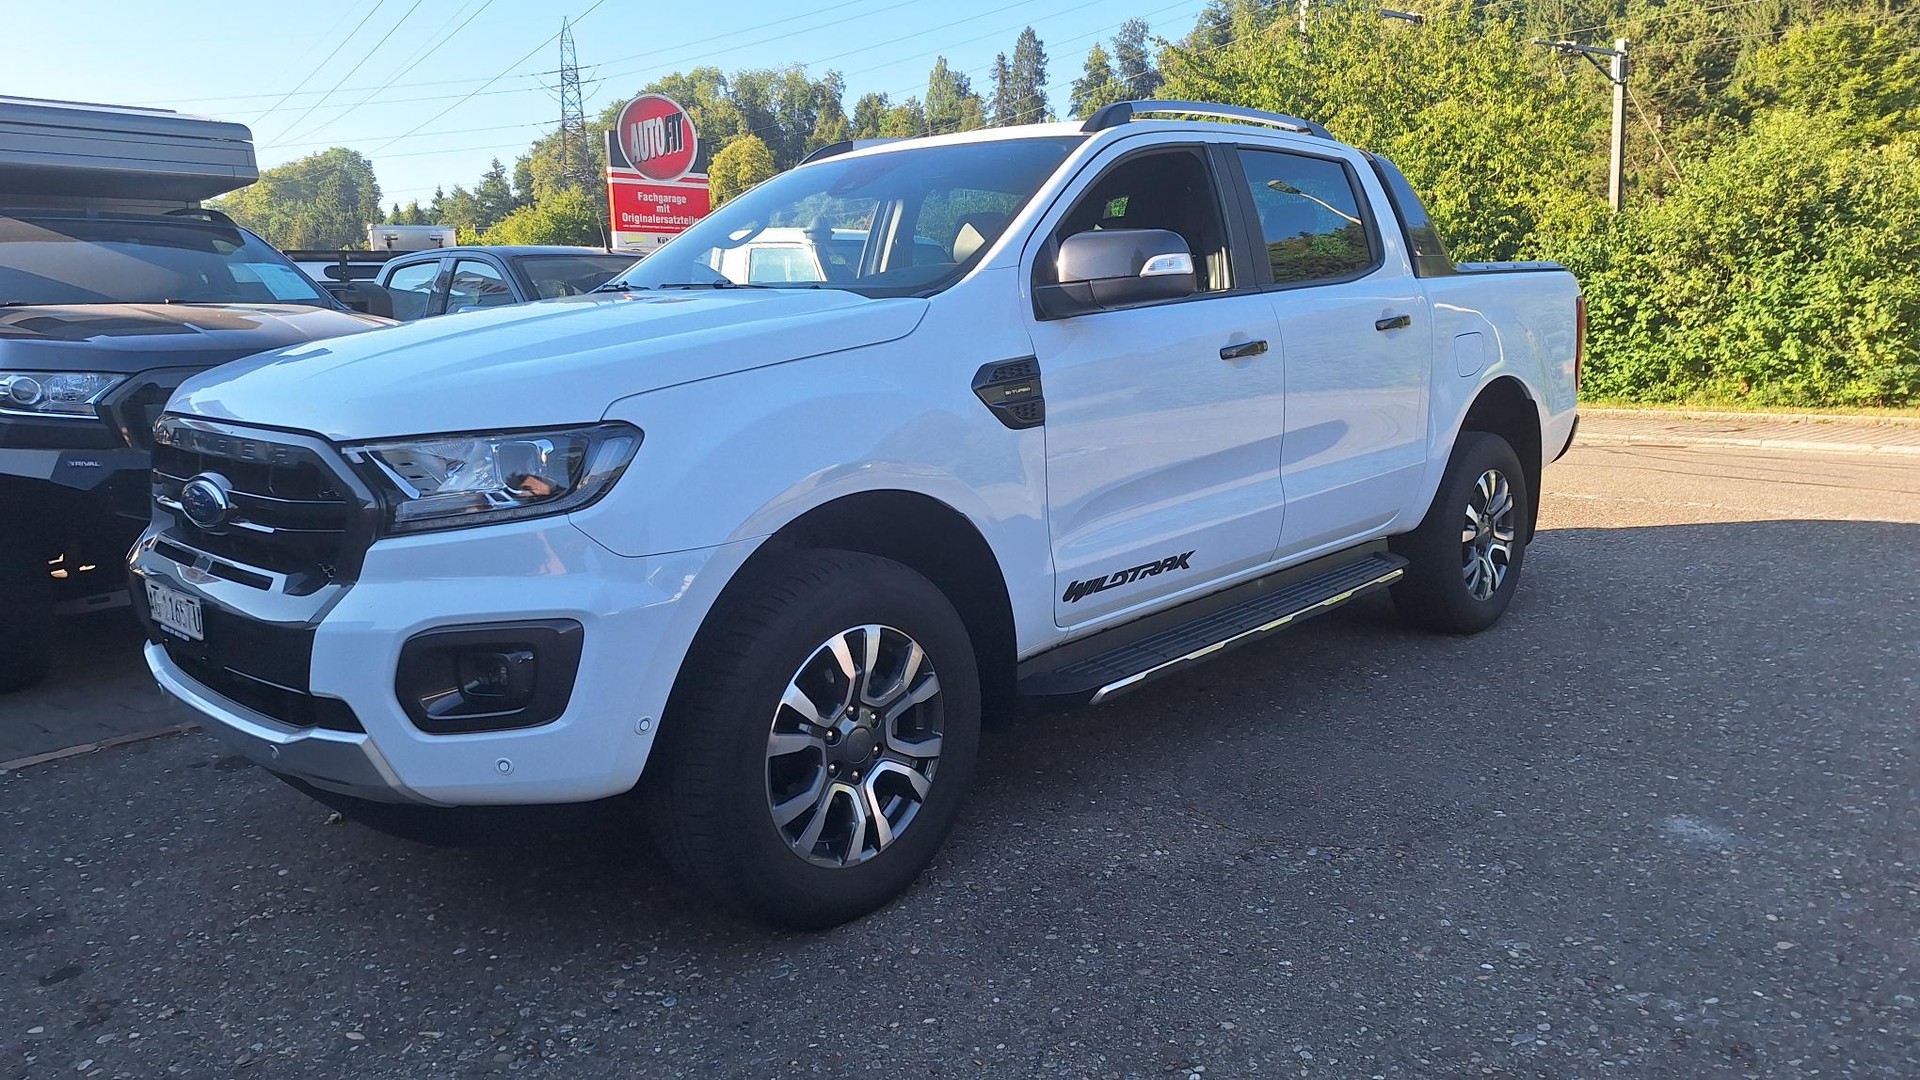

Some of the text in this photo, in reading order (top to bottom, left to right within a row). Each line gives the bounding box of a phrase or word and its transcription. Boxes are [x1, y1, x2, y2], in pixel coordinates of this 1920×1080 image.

[637, 191, 687, 204] Fachgarage
[656, 204, 671, 213] mit
[1062, 549, 1196, 603] WILDTRAK
